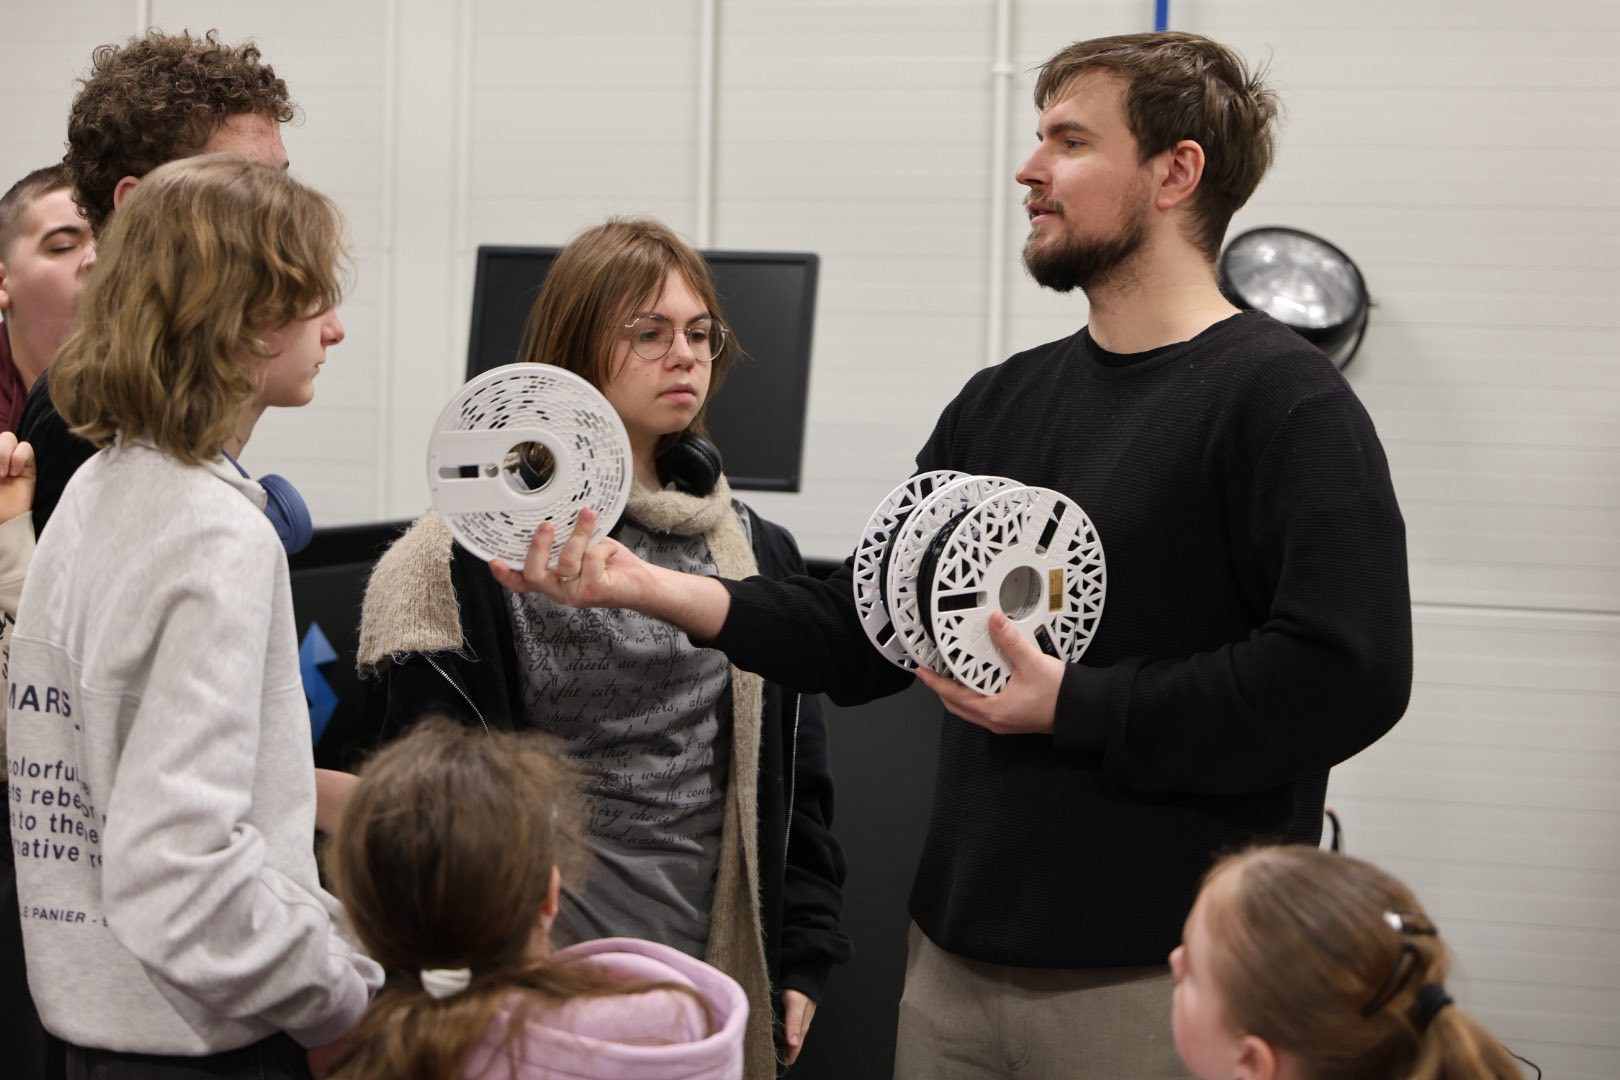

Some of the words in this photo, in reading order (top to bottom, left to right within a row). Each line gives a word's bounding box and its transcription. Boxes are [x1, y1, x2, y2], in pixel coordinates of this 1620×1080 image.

[565, 651, 618, 671] streets
[544, 702, 588, 727] speak
[592, 714, 607, 723] in
[32, 907, 86, 923] PANIER
